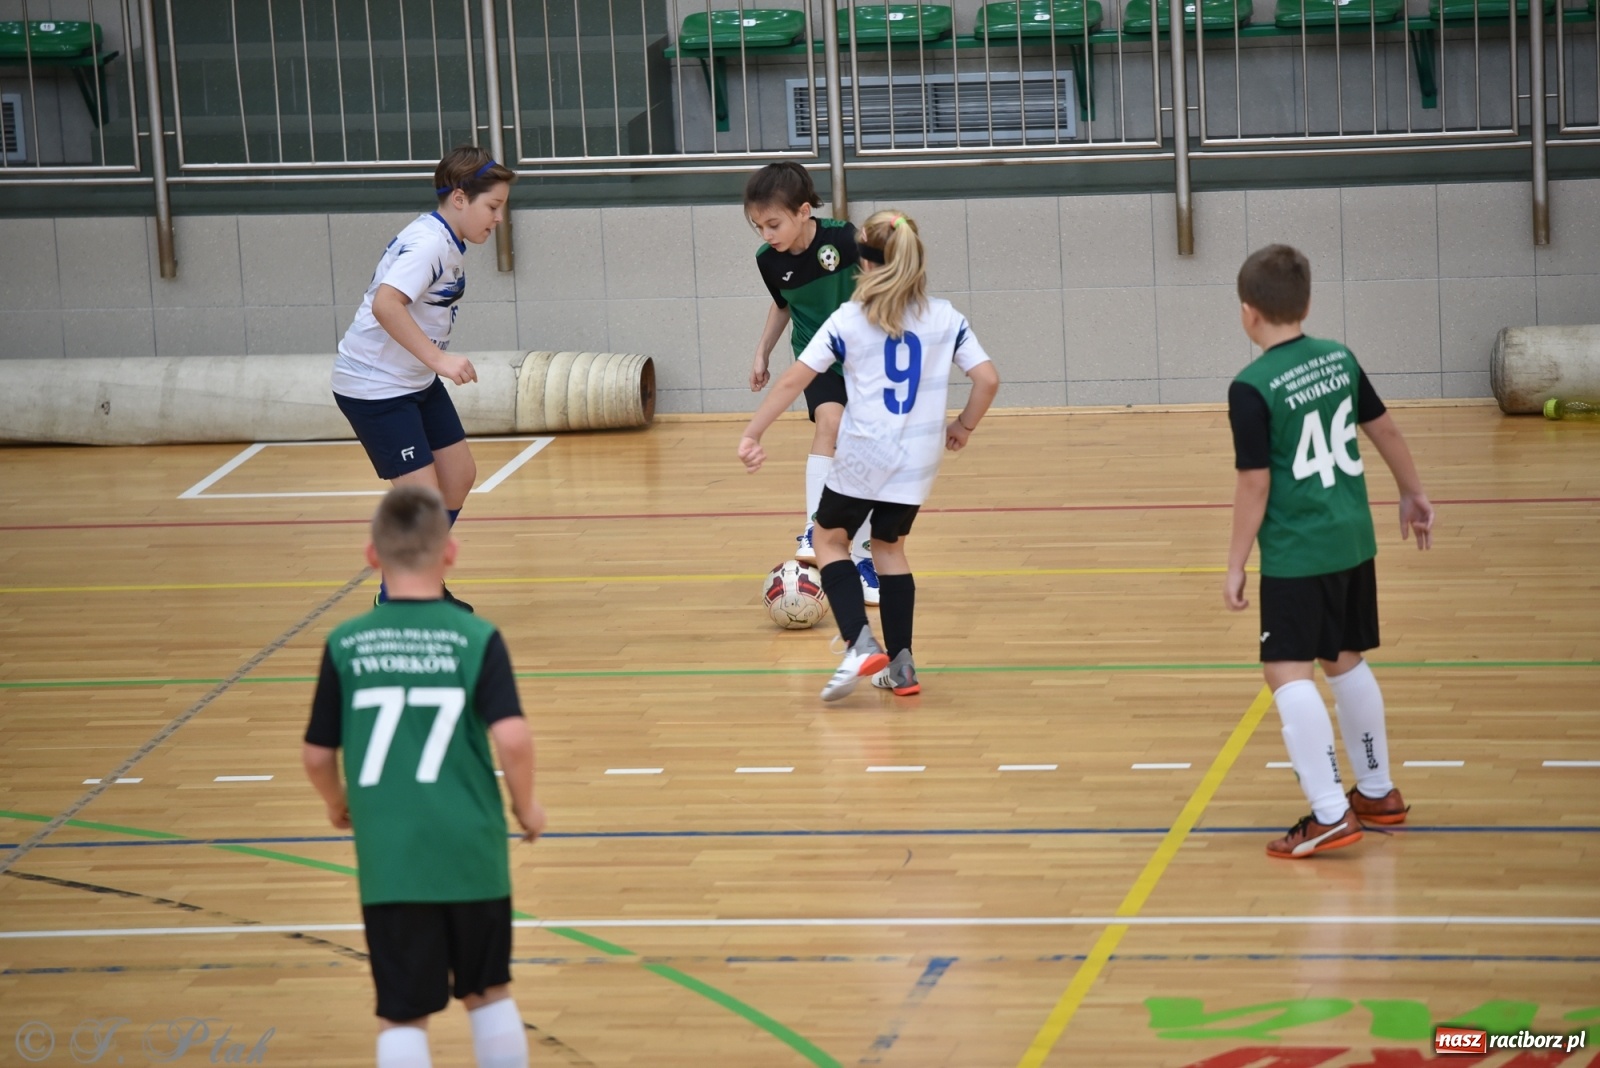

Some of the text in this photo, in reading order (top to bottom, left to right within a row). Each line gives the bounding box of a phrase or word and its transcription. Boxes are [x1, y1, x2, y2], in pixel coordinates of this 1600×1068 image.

[883, 330, 922, 415] 9
[1292, 395, 1364, 489] 46
[351, 685, 466, 787] 77
